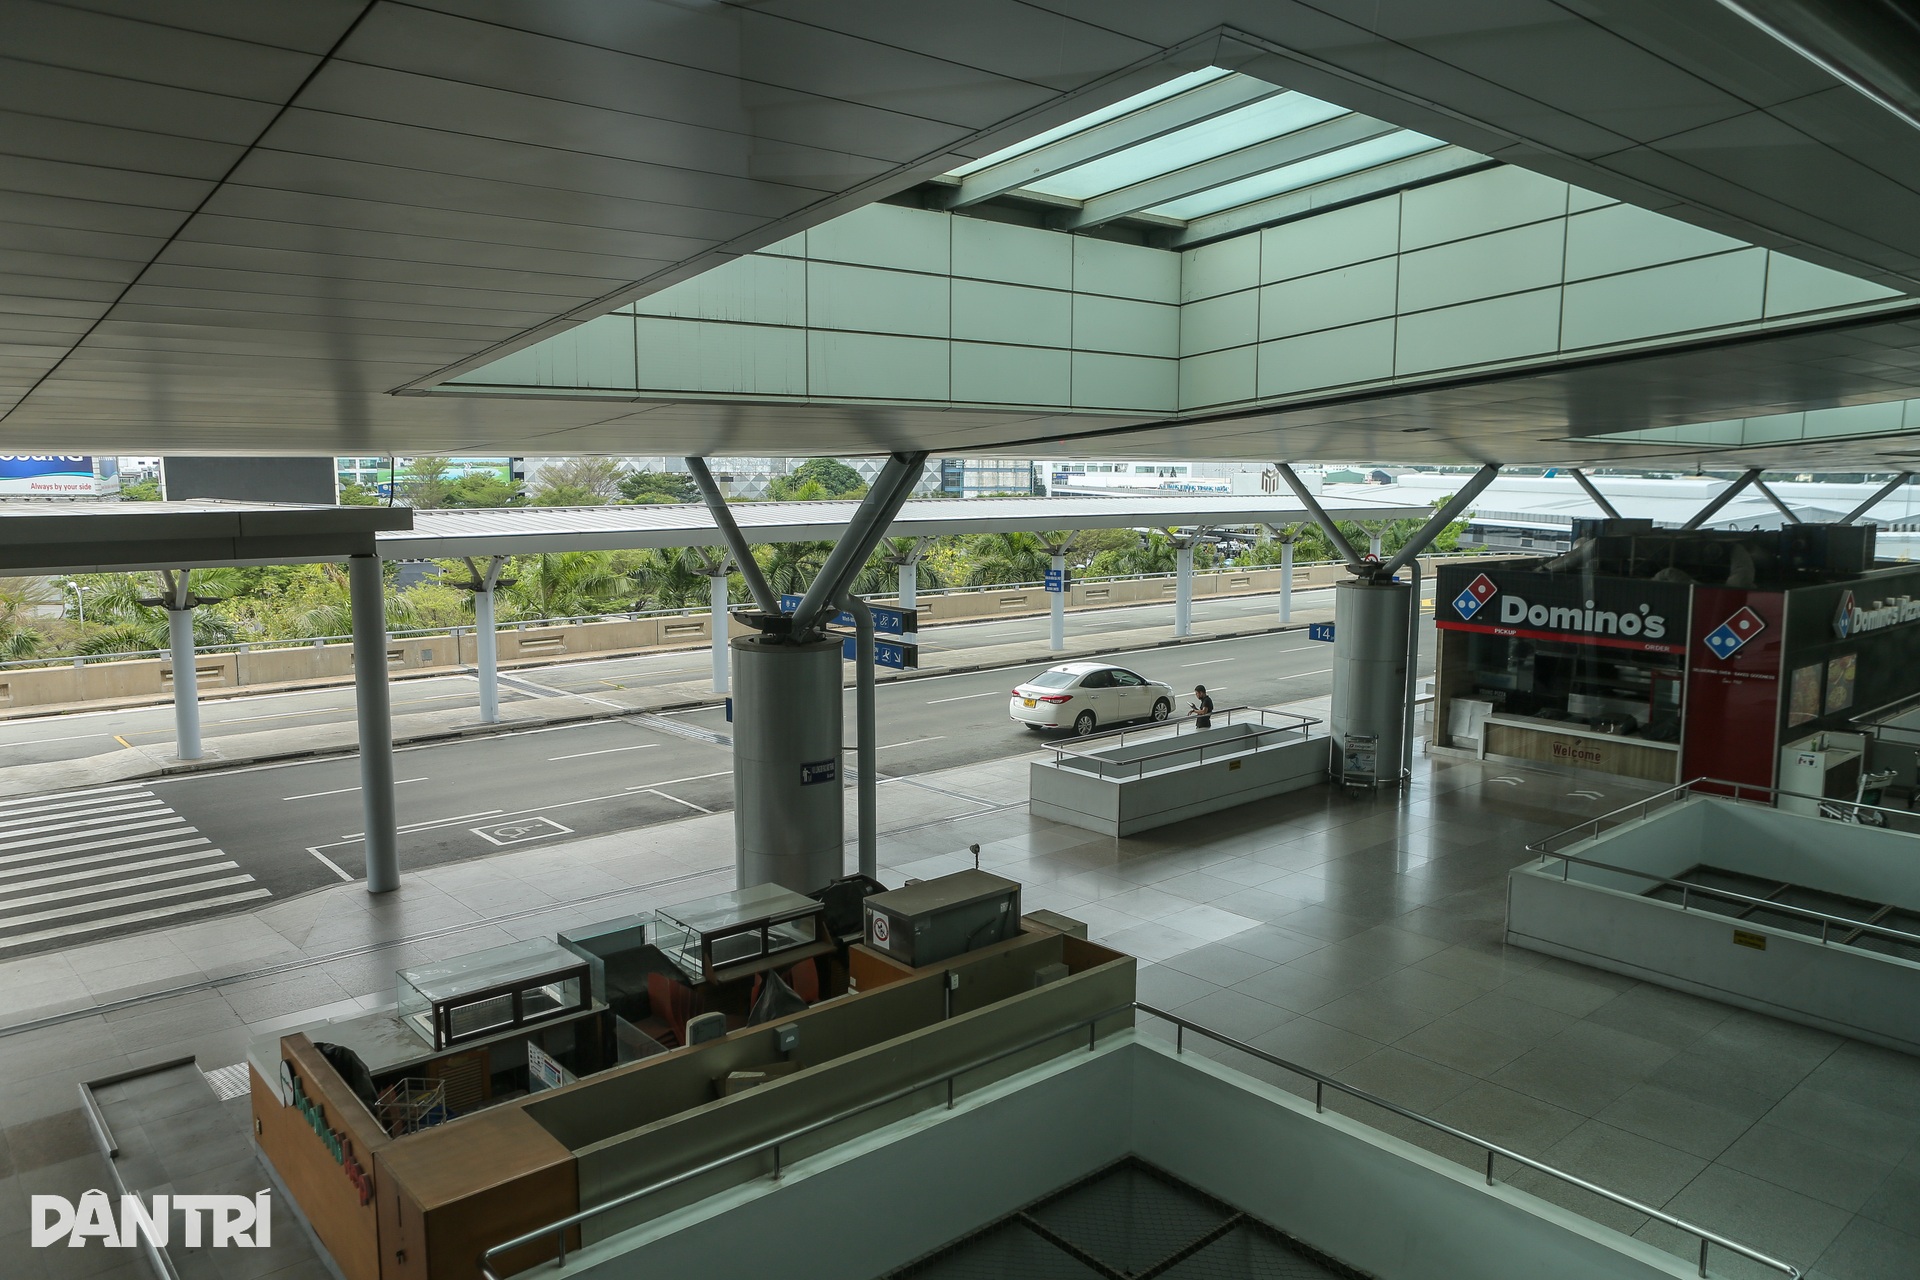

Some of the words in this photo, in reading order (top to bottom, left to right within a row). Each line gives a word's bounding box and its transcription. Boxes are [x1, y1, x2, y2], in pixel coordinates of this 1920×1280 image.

[54, 483, 62, 491] by
[1500, 595, 1666, 639] Domino's
[1853, 597, 1898, 633] Domino's
[1316, 627, 1330, 639] 14
[1494, 628, 1517, 636] PICKUP
[1644, 643, 1670, 652] ORDER
[1552, 744, 1602, 762] Welcome
